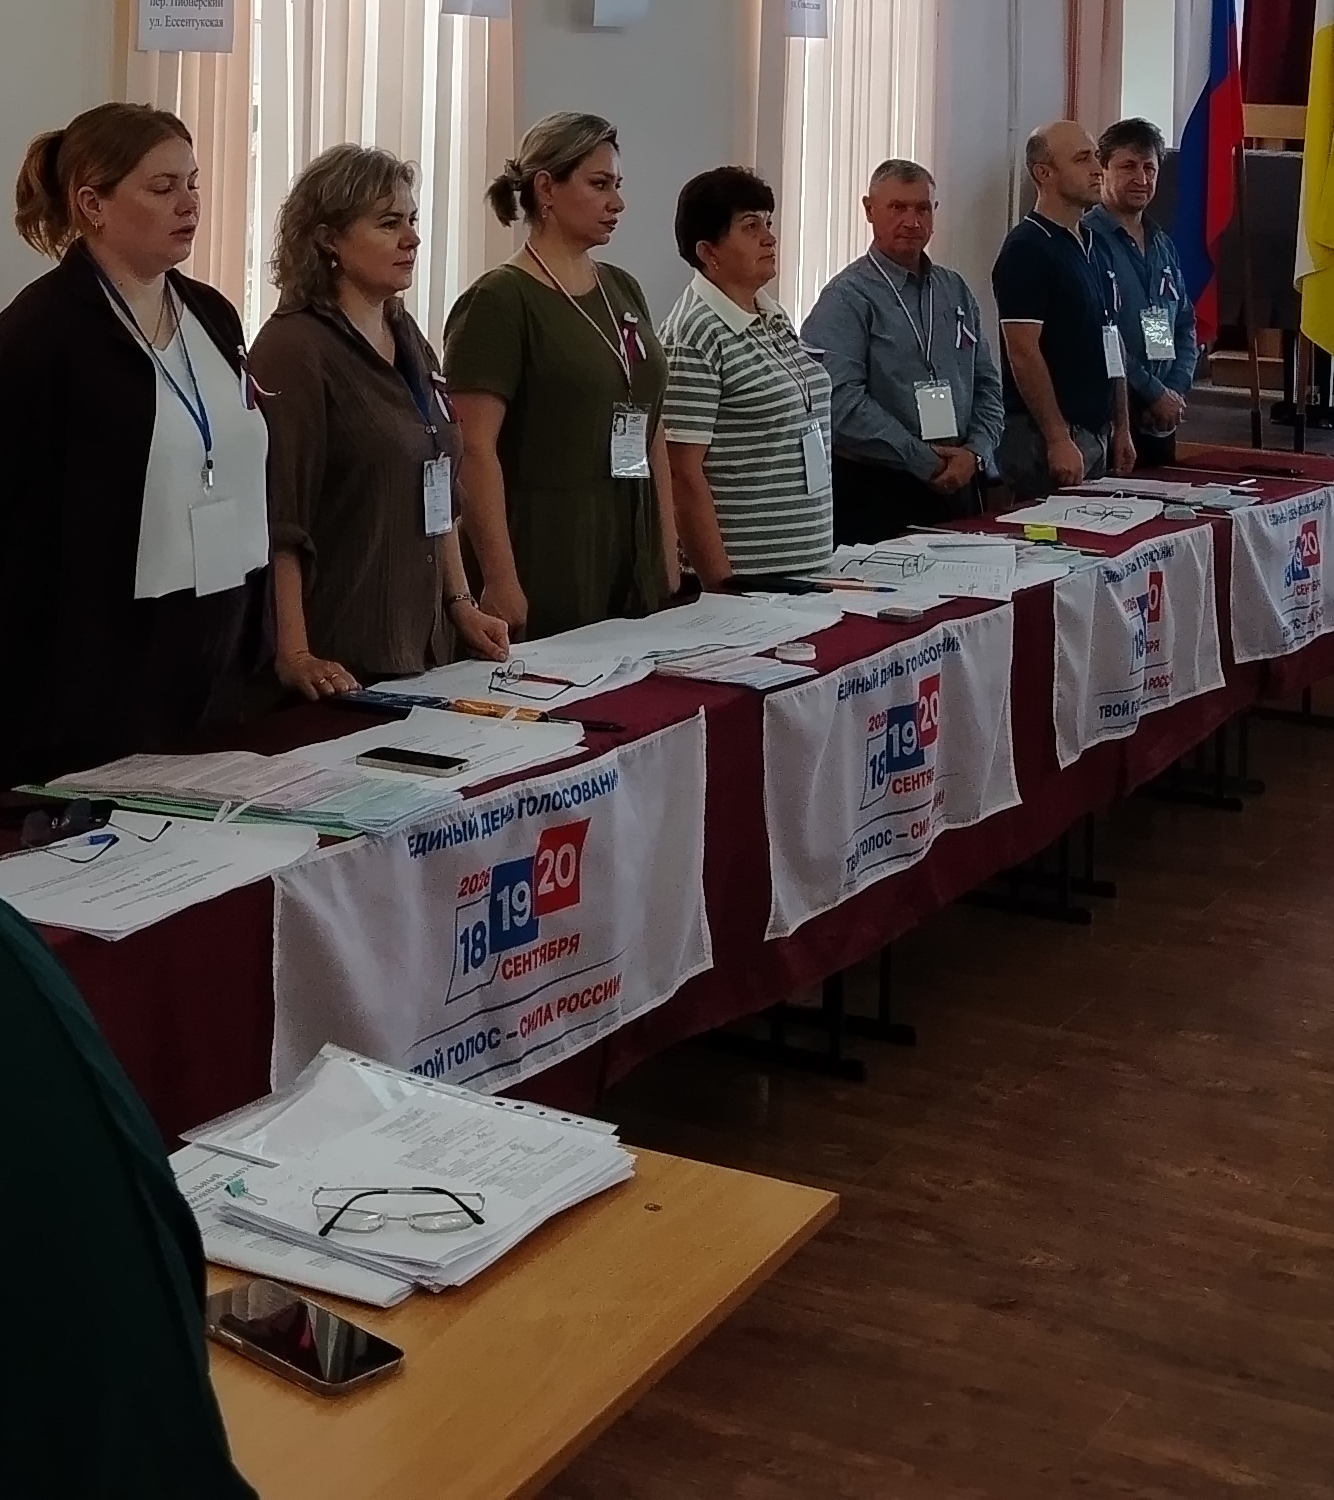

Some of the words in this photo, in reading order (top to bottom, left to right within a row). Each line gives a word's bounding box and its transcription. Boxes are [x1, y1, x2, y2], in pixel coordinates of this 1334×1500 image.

[149, 17, 162, 30] ул.
[165, 15, 223, 30] Ессентукская
[1099, 703, 1132, 719] ТВОЙ
[888, 720, 917, 758] 19
[408, 812, 479, 858] ЕДИНЫЙ
[481, 802, 515, 840] ДЕНЬ
[517, 768, 619, 819] ГОЛОСОВАНИ
[460, 921, 486, 975] 18
[496, 880, 531, 932] 19
[537, 843, 576, 896] 20
[501, 933, 581, 980] СЕНТЯБРЯ
[447, 1027, 501, 1070] ГОЛОС
[520, 1003, 554, 1038] СИЛА
[557, 971, 622, 1018] РОССИИ
